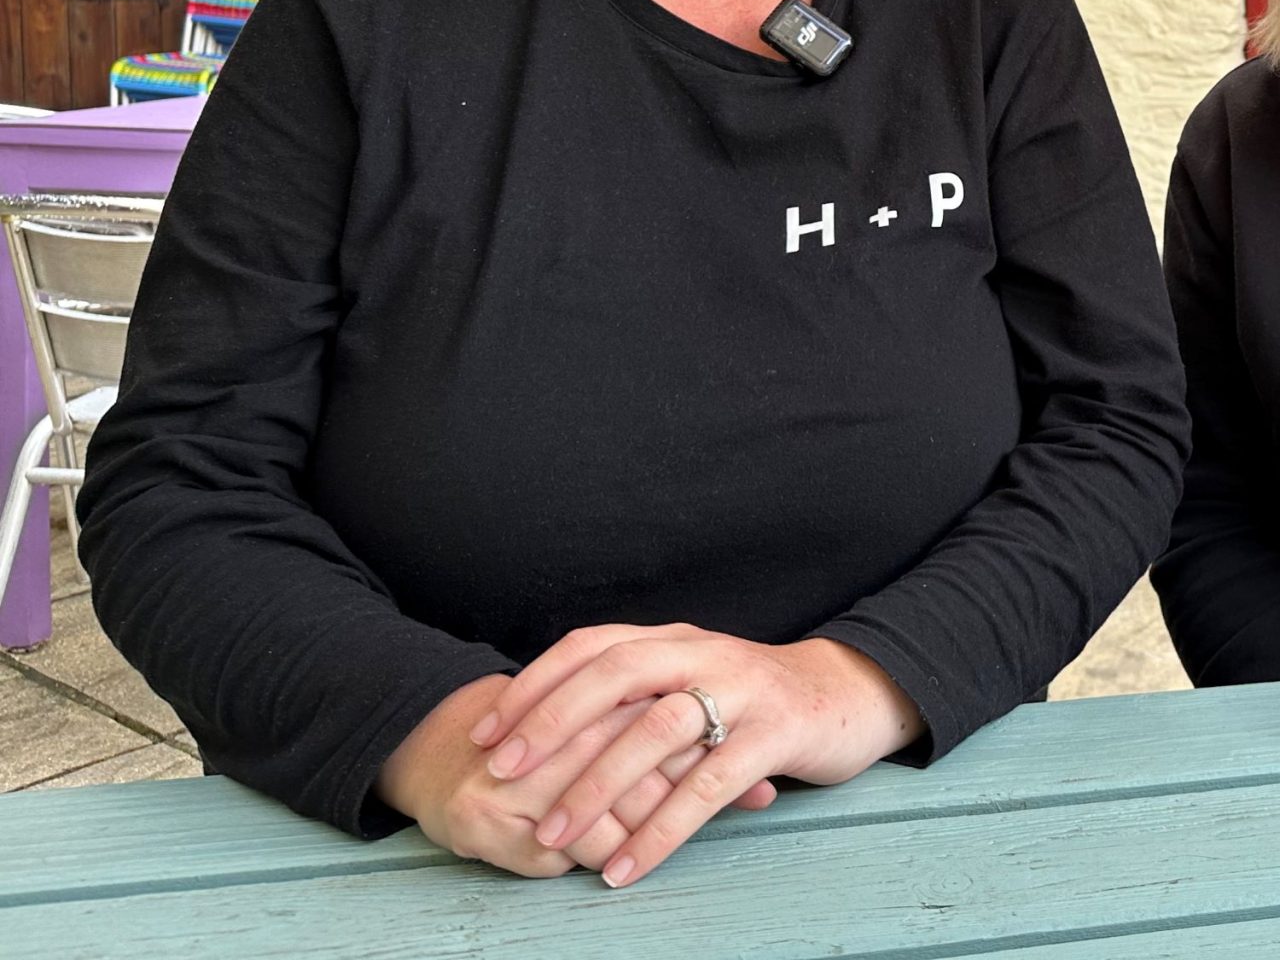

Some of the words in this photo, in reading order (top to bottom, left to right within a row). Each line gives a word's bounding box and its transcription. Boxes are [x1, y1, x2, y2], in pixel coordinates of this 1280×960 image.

[786, 202, 835, 253] H
[869, 206, 898, 228] +
[928, 172, 965, 228] P
